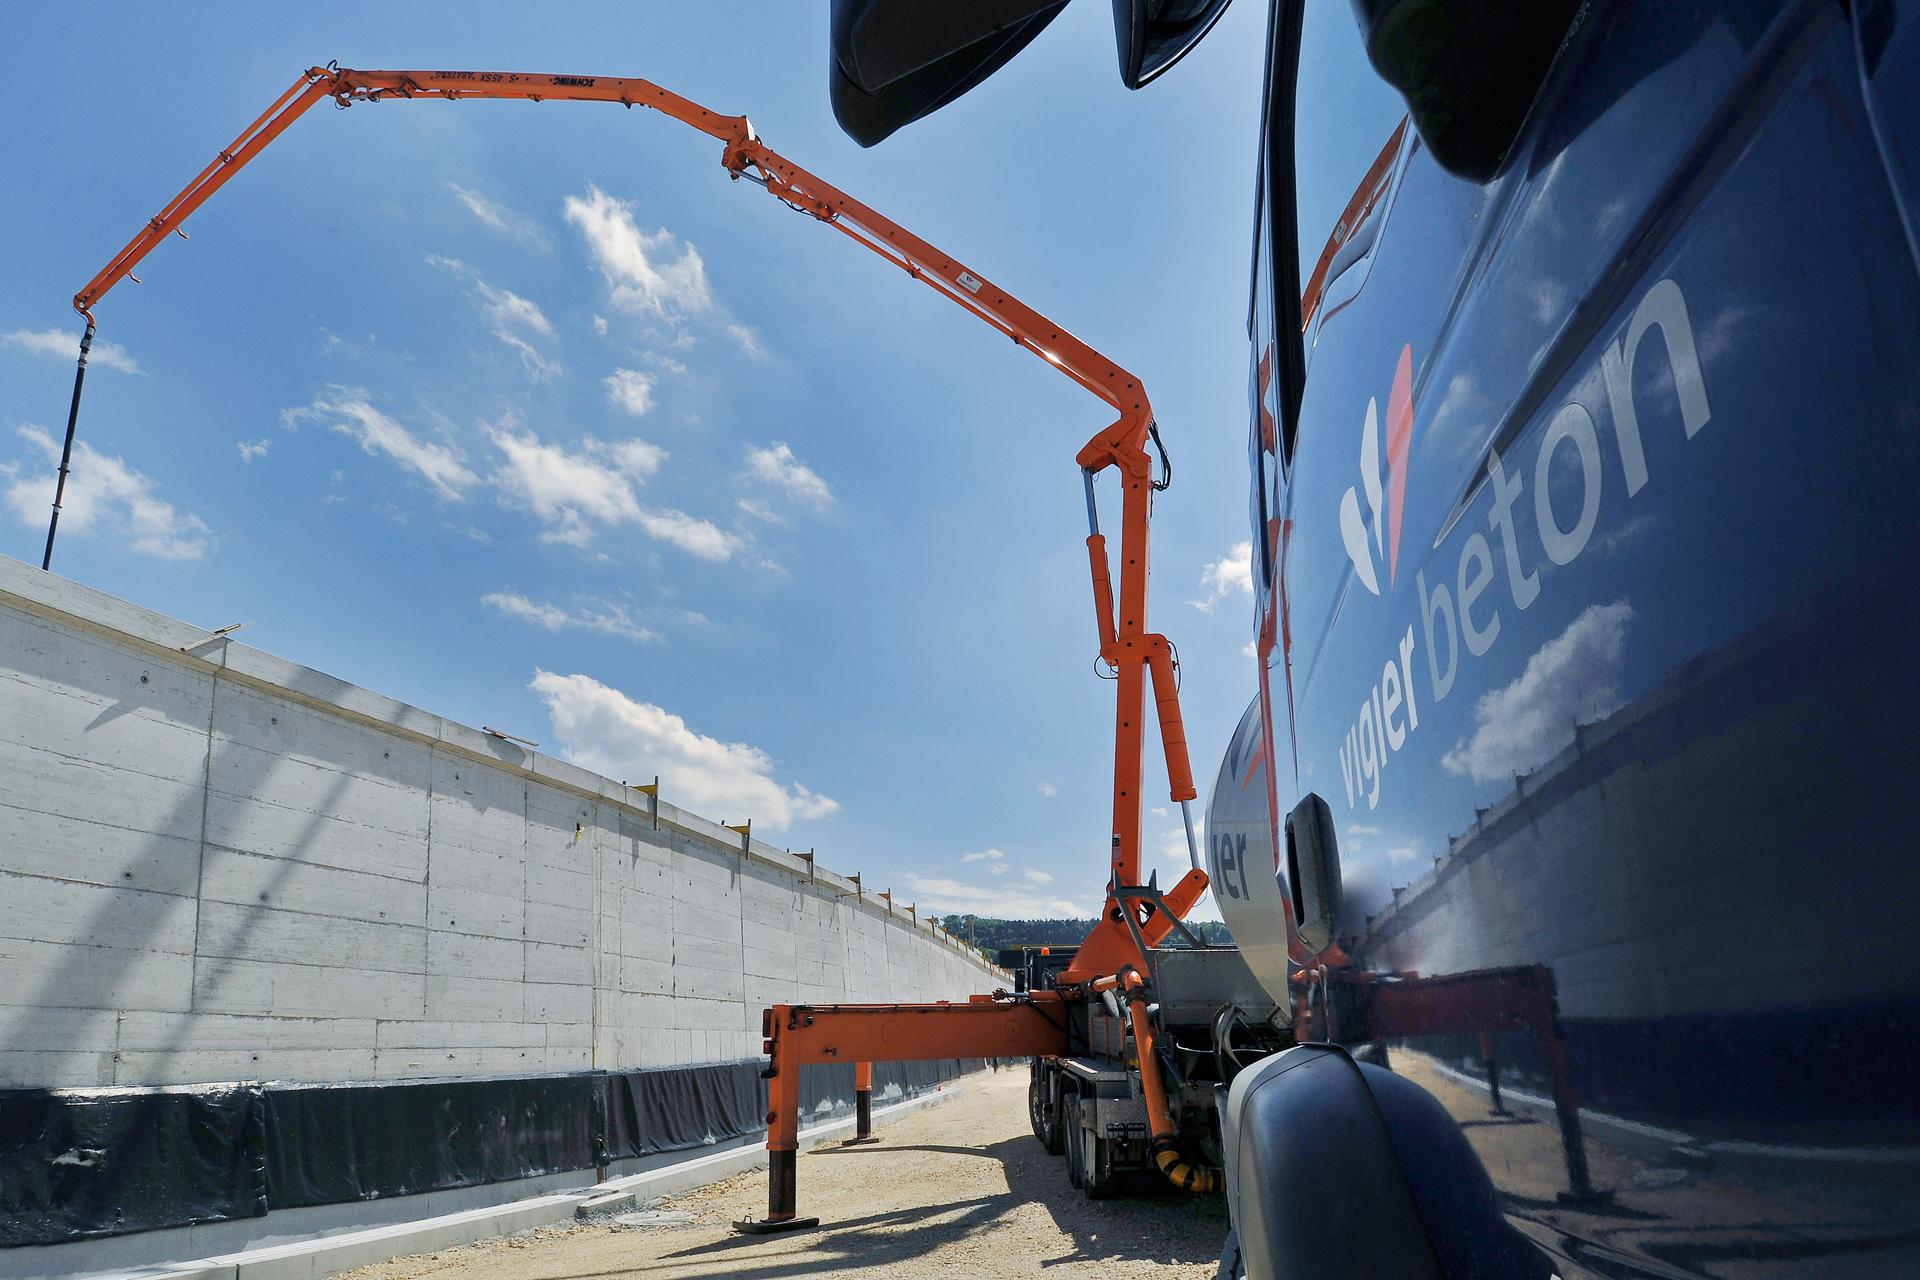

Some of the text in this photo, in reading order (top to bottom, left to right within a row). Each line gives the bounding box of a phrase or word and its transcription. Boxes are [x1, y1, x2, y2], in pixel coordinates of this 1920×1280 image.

[553, 76, 595, 87] SCHWING
[1339, 278, 1711, 811] vigier beton
